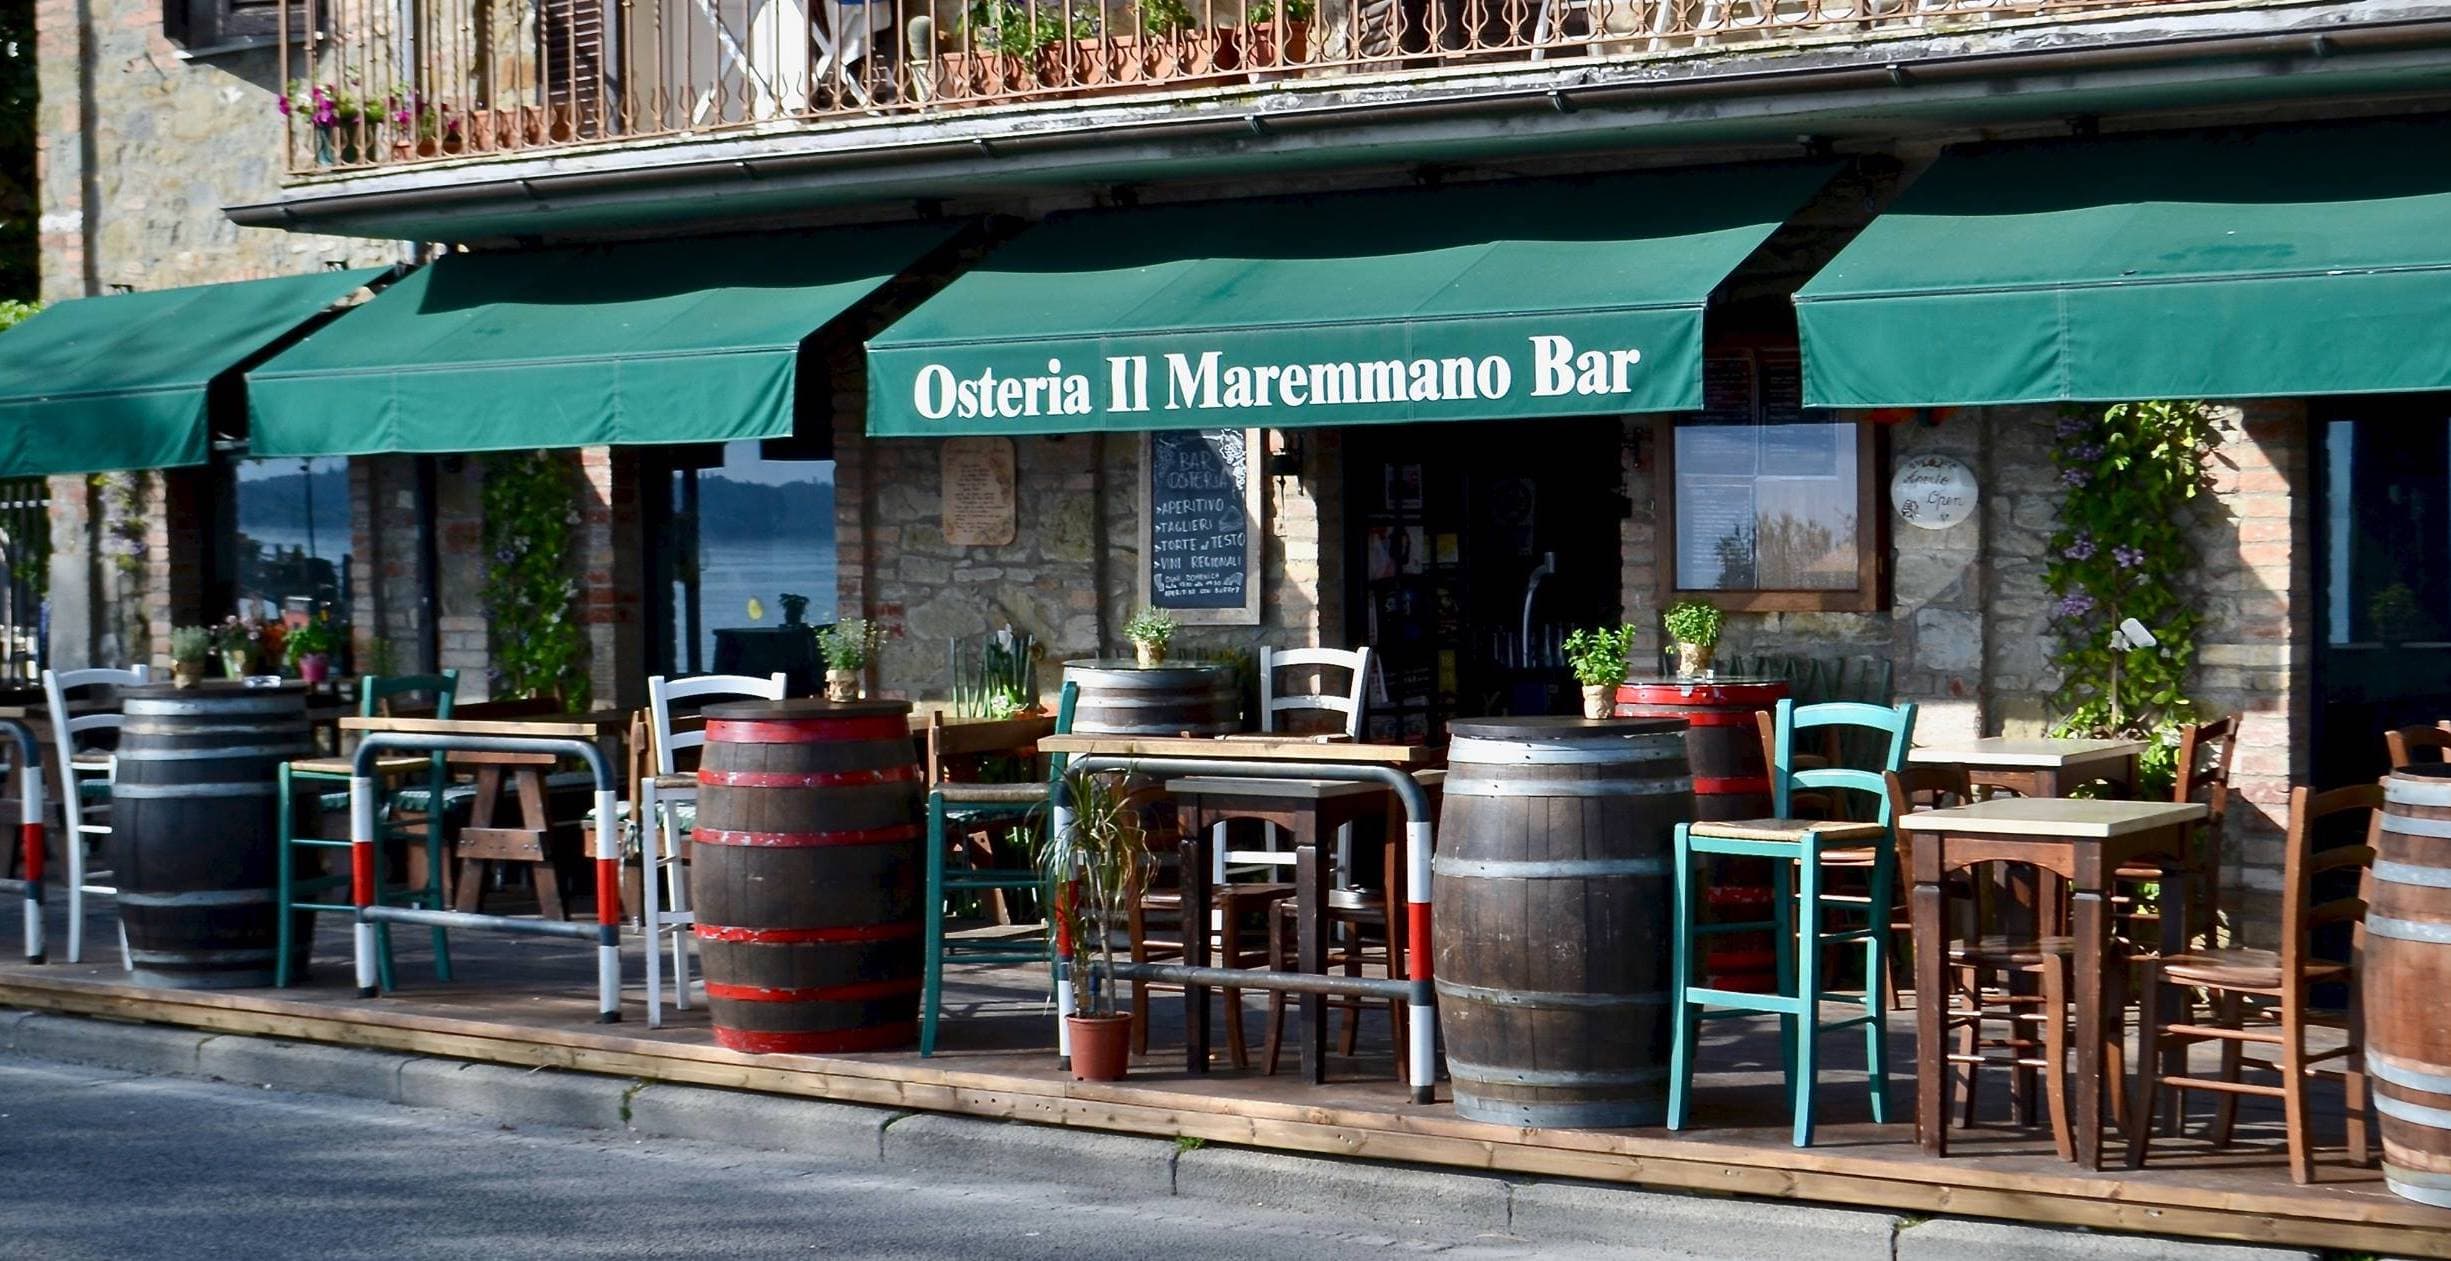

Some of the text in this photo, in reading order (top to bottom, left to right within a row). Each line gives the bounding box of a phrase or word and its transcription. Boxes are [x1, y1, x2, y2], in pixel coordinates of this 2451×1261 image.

[914, 358, 1092, 419] Osteria
[1106, 355, 1150, 412] Il
[1163, 351, 1512, 410] Maremmano
[1528, 335, 1641, 397] Bar
[1180, 451, 1214, 471] BAR
[1168, 470, 1228, 489] OSTERIA
[1161, 498, 1224, 515] APERITIVO
[1927, 490, 1965, 512] Open
[1160, 518, 1213, 533] TAGLIERI
[1160, 538, 1197, 551] TORTE
[1210, 532, 1246, 549] TESTO
[1160, 555, 1241, 570] VINI REGIONALI
